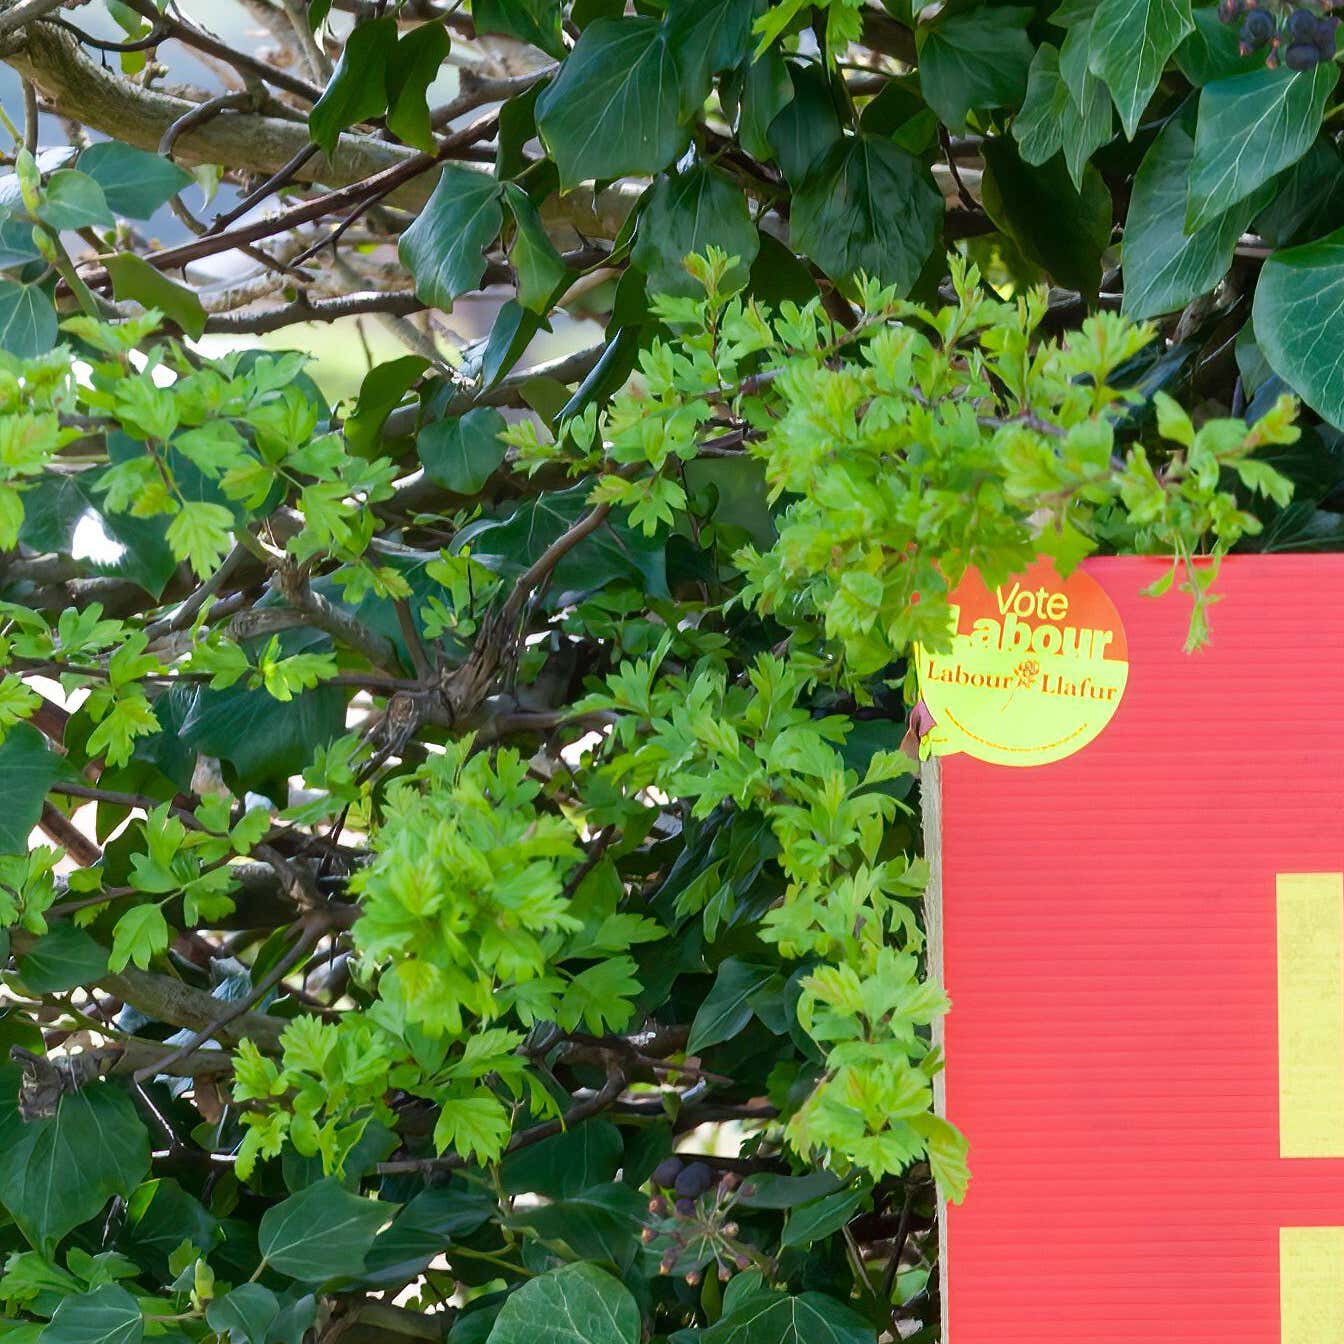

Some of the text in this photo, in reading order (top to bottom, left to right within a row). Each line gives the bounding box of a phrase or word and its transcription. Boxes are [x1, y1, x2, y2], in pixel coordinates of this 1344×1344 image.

[996, 582, 1069, 621] Vote
[927, 659, 1118, 701] Labour Llafur
